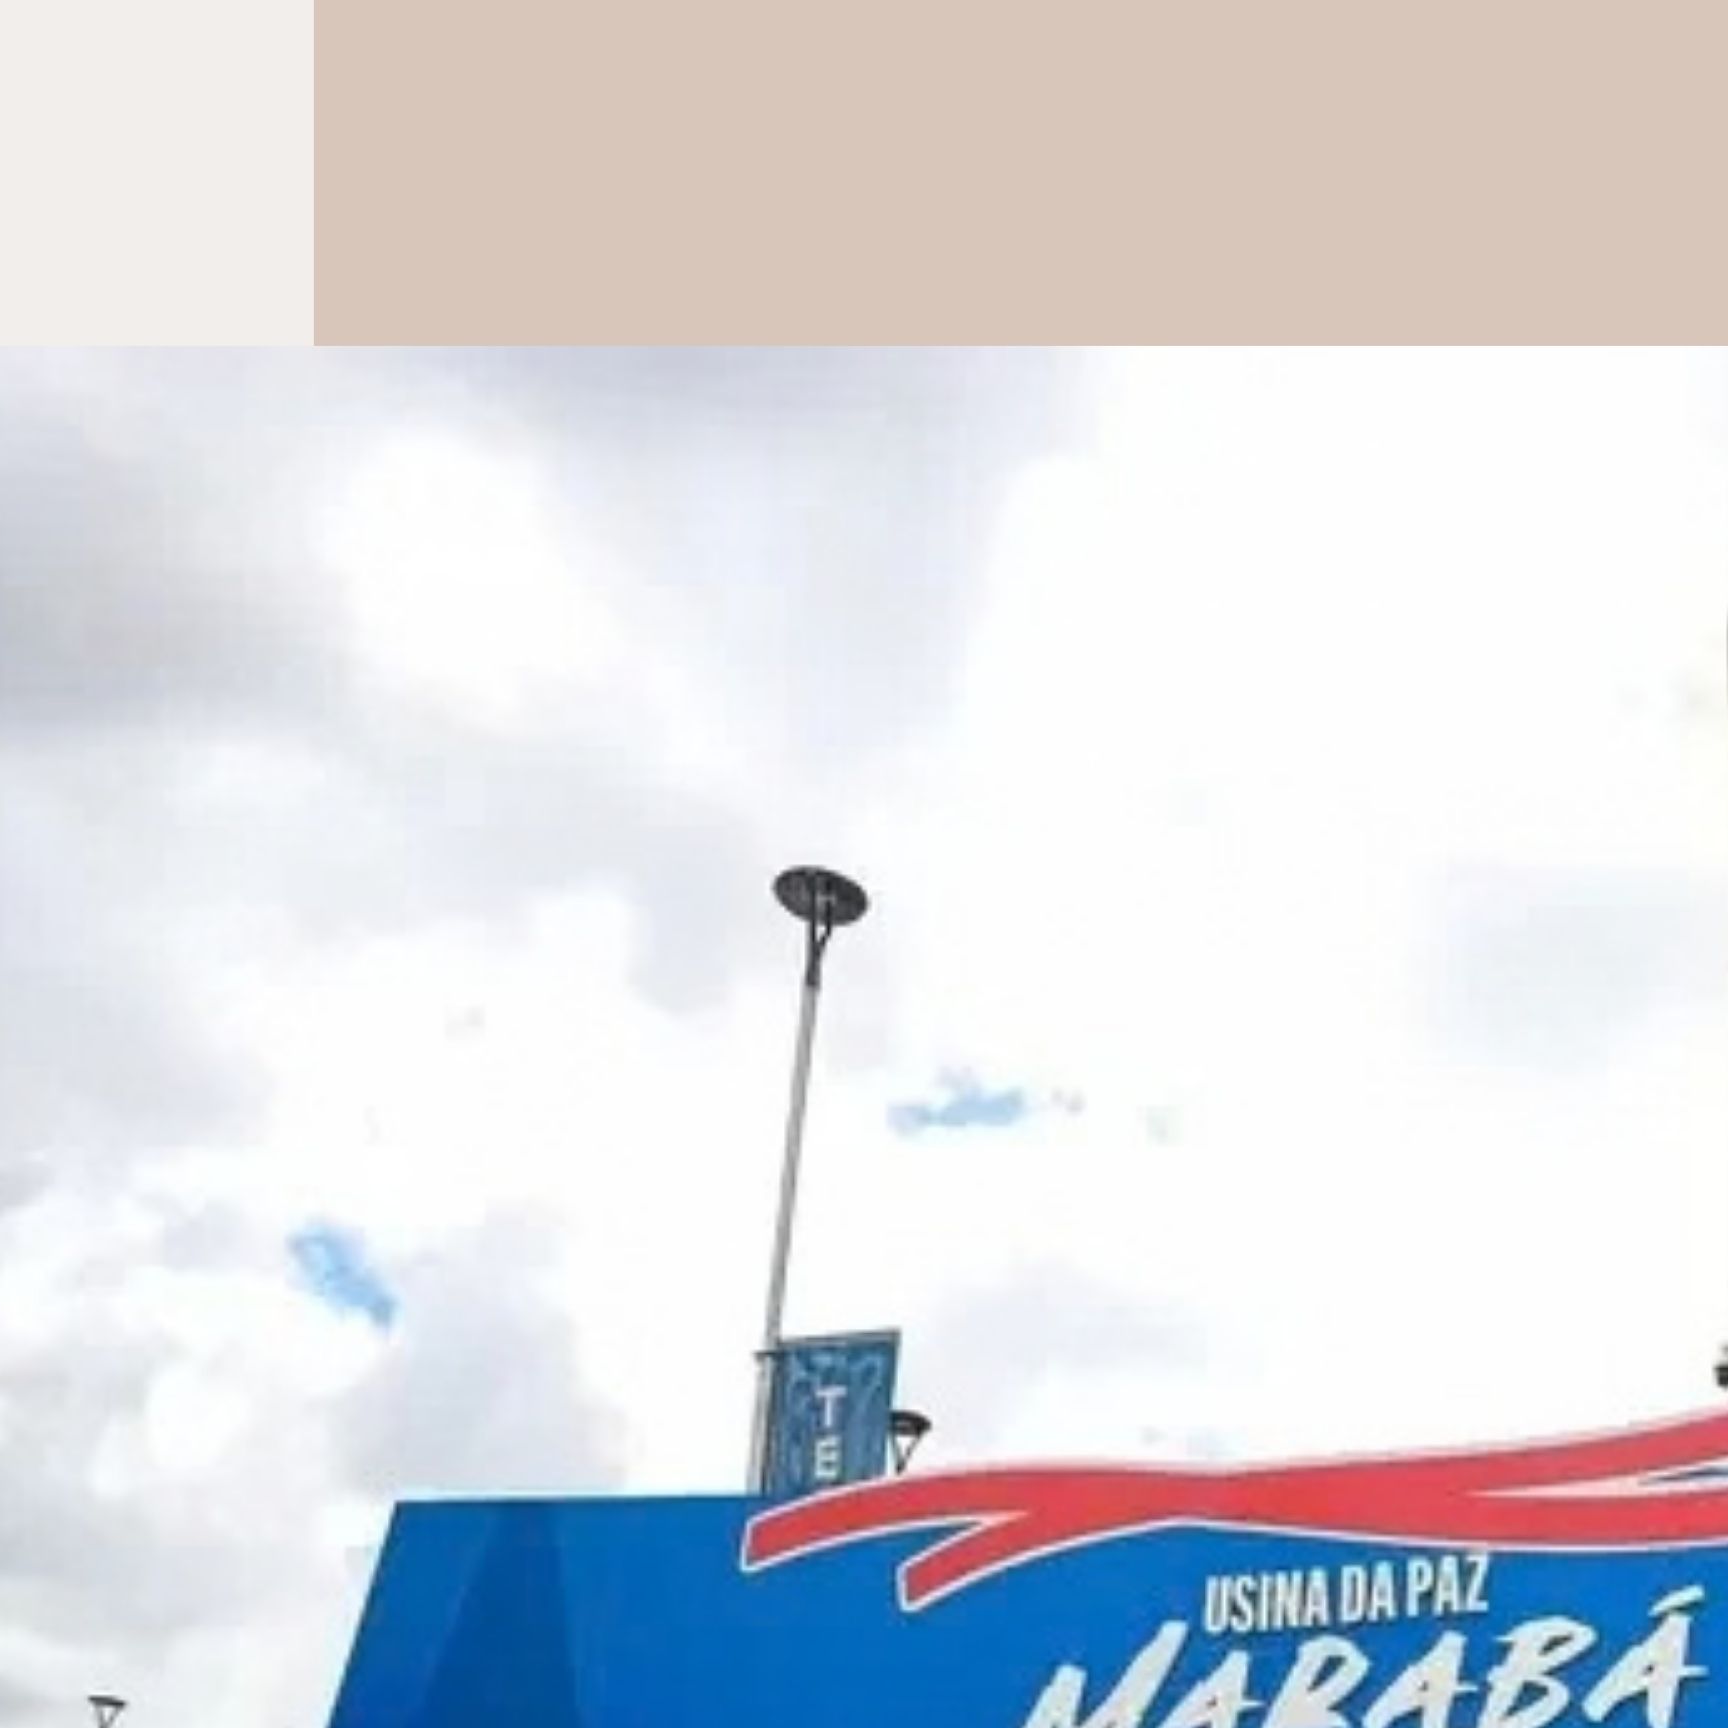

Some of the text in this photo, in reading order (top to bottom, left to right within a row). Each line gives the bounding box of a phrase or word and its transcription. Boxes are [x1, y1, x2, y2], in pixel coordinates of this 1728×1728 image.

[1204, 1551, 1489, 1635] USINA DA PAZ
